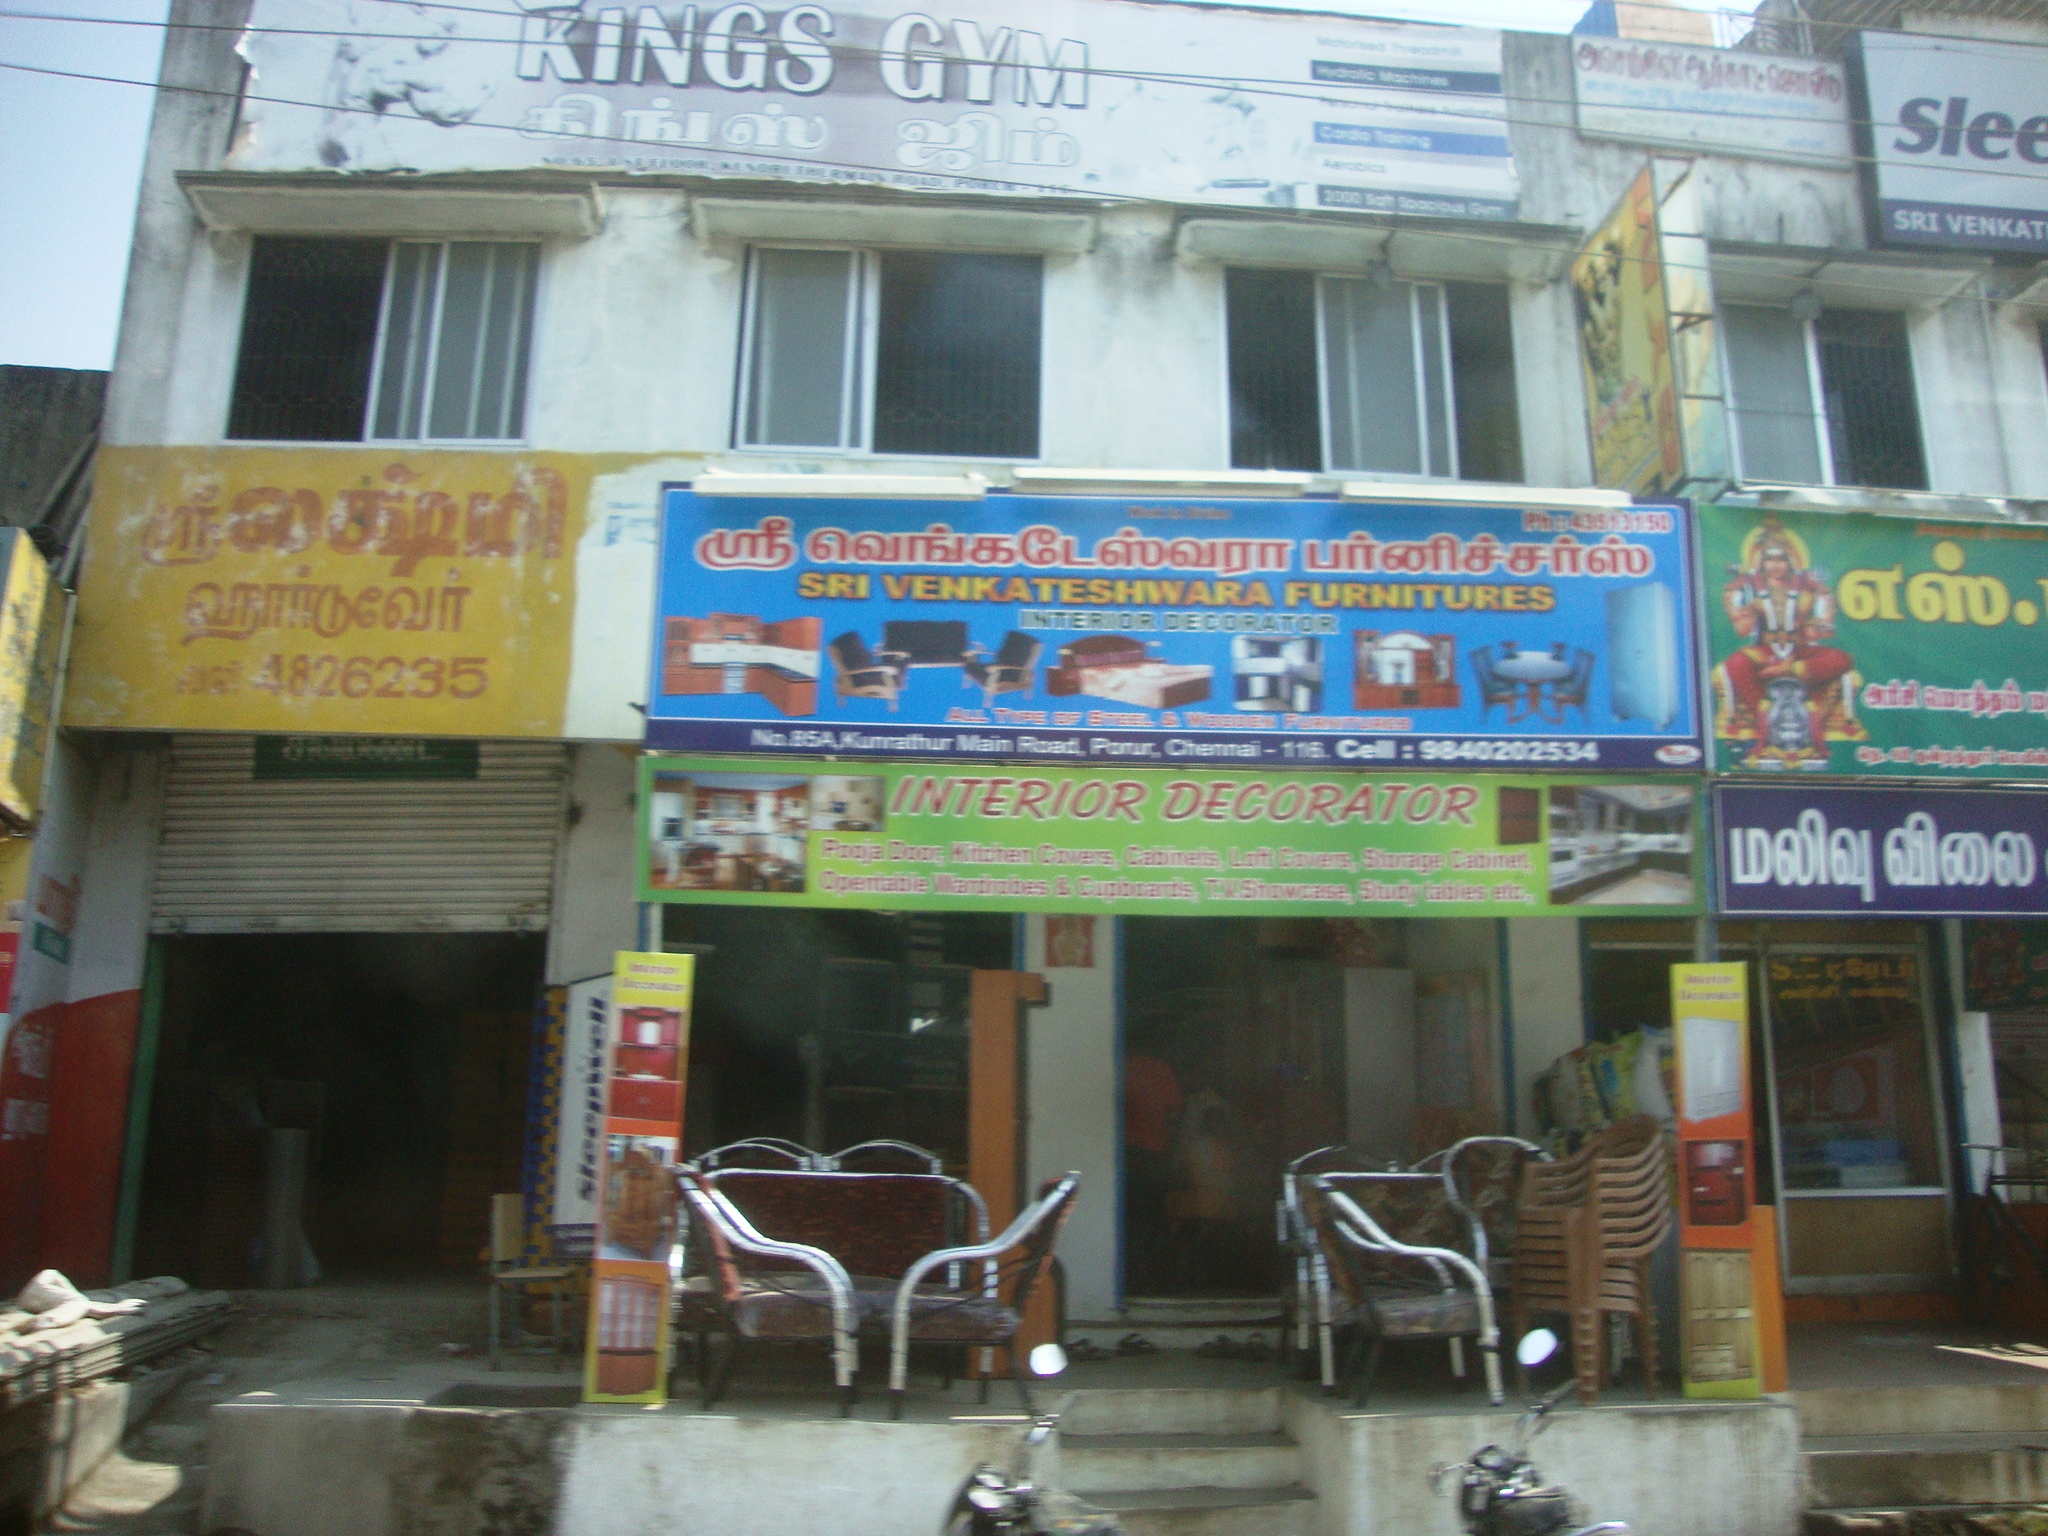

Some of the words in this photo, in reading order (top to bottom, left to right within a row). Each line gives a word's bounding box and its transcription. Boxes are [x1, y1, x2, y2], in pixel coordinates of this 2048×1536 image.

[517, 2, 836, 95] KINGS
[880, 12, 1090, 108] GYM
[896, 111, 1079, 171] ஜிம்
[1893, 96, 2048, 165] Slee
[1894, 209, 1941, 234] SRI
[1946, 213, 2048, 241] VENKAT
[695, 515, 797, 570] ஸ்ரீ
[805, 523, 1293, 577] வெங்கடேஸ்வரா
[1304, 531, 1656, 577] பர்னிச்சர்ஸ்
[798, 572, 870, 600] SRI
[882, 575, 1273, 608] VENKATESHWARA
[1284, 580, 1556, 612] FURNITURES
[1836, 540, 2048, 627] எஸ்.
[1019, 609, 1157, 631] INTERIOR
[1163, 611, 1340, 635] DECORATOR
[251, 653, 490, 700] 4826235
[946, 705, 990, 724] ALL
[994, 707, 1047, 725] TYPE
[957, 733, 1012, 753] Main
[1018, 735, 1085, 757] Road,
[1166, 737, 1259, 759] Chennai
[1335, 739, 1396, 761] Cell
[1418, 740, 1600, 763] 9840202534
[888, 775, 1152, 825] INTERIOR
[1161, 780, 1480, 827] DECORATOR
[950, 840, 1033, 867] Kitchen
[1036, 843, 1121, 871] Covers,
[1228, 847, 1277, 870] Loft
[1363, 848, 1448, 876] Storage
[1728, 808, 1877, 903] மலிவு
[1882, 811, 2037, 888] விலை
[933, 872, 1048, 900] Wardrobes
[1359, 878, 1423, 906] Study
[1425, 879, 1487, 902] tables
